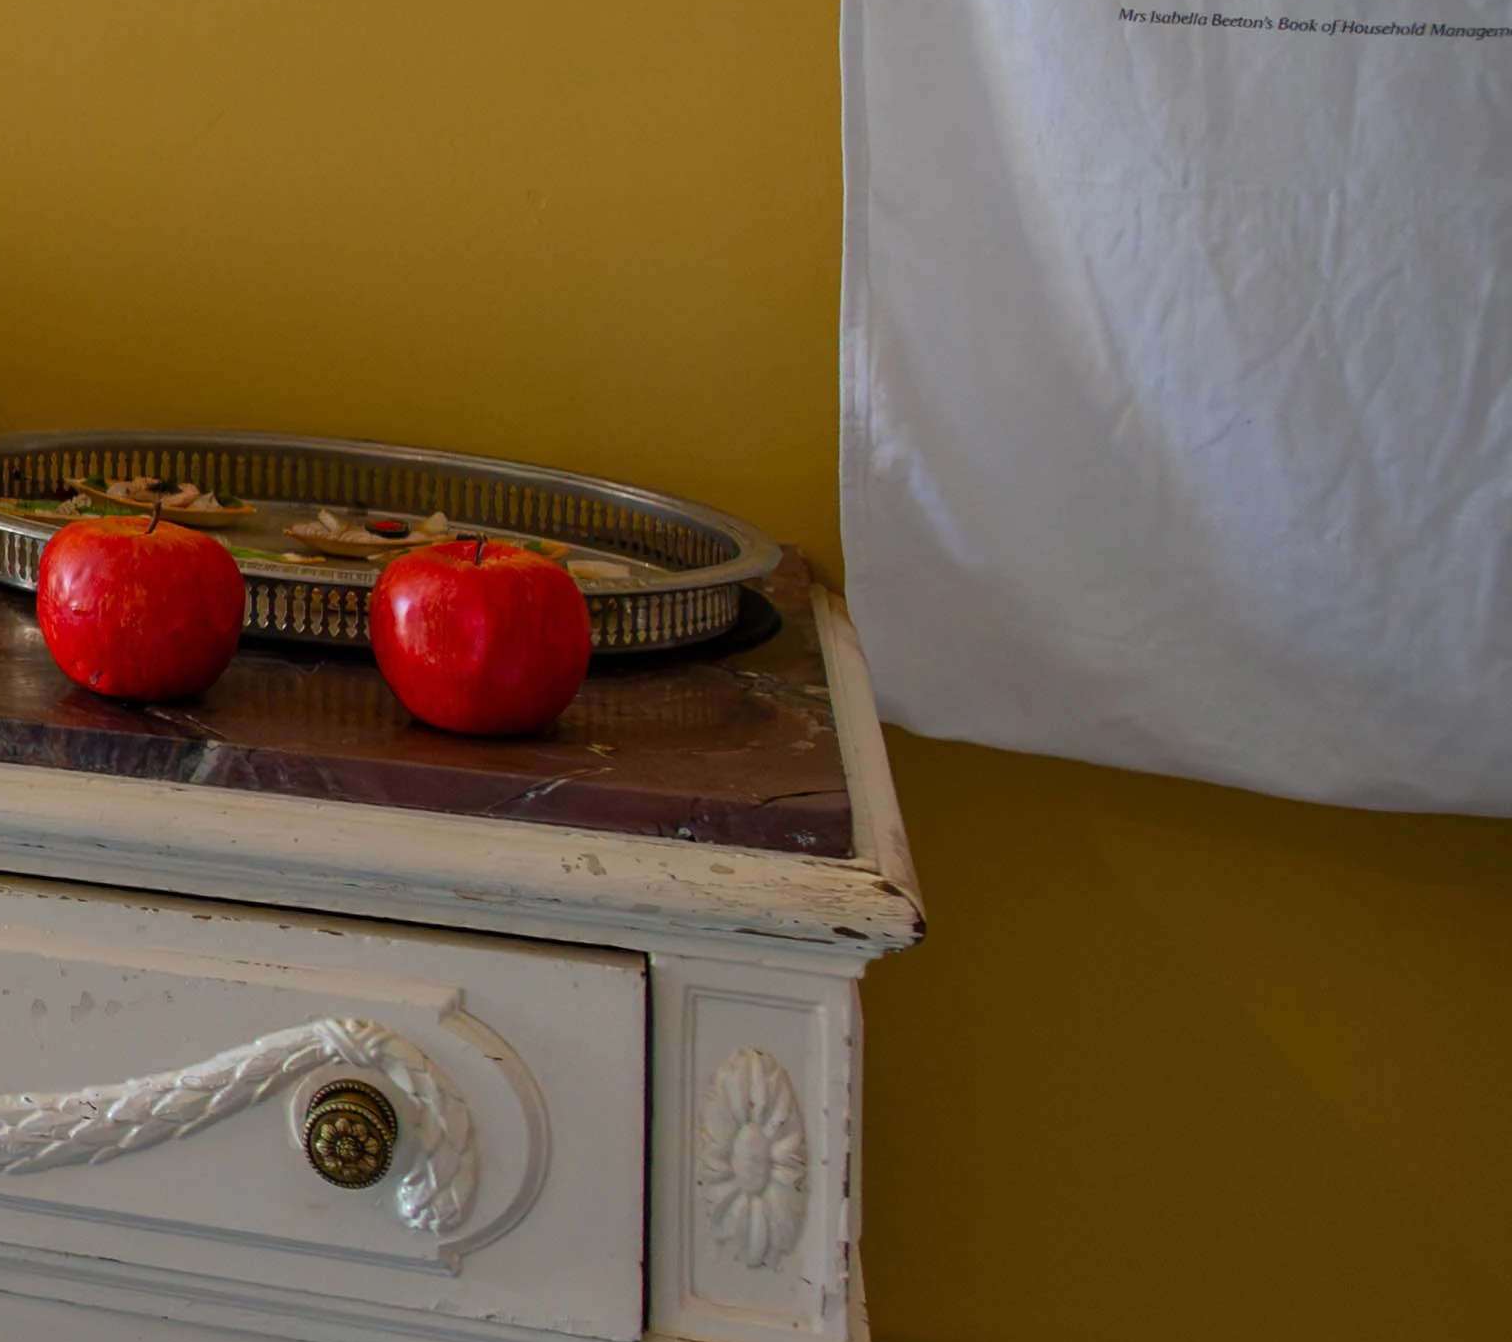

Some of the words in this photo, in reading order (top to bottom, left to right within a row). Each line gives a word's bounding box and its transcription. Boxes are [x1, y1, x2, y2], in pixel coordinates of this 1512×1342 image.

[1118, 8, 1147, 23] Mrs
[1149, 11, 1208, 26] Isabella
[1277, 16, 1319, 32] Book
[1321, 19, 1341, 36] of
[1341, 20, 1426, 36] Household
[1430, 23, 1512, 41] Managem
